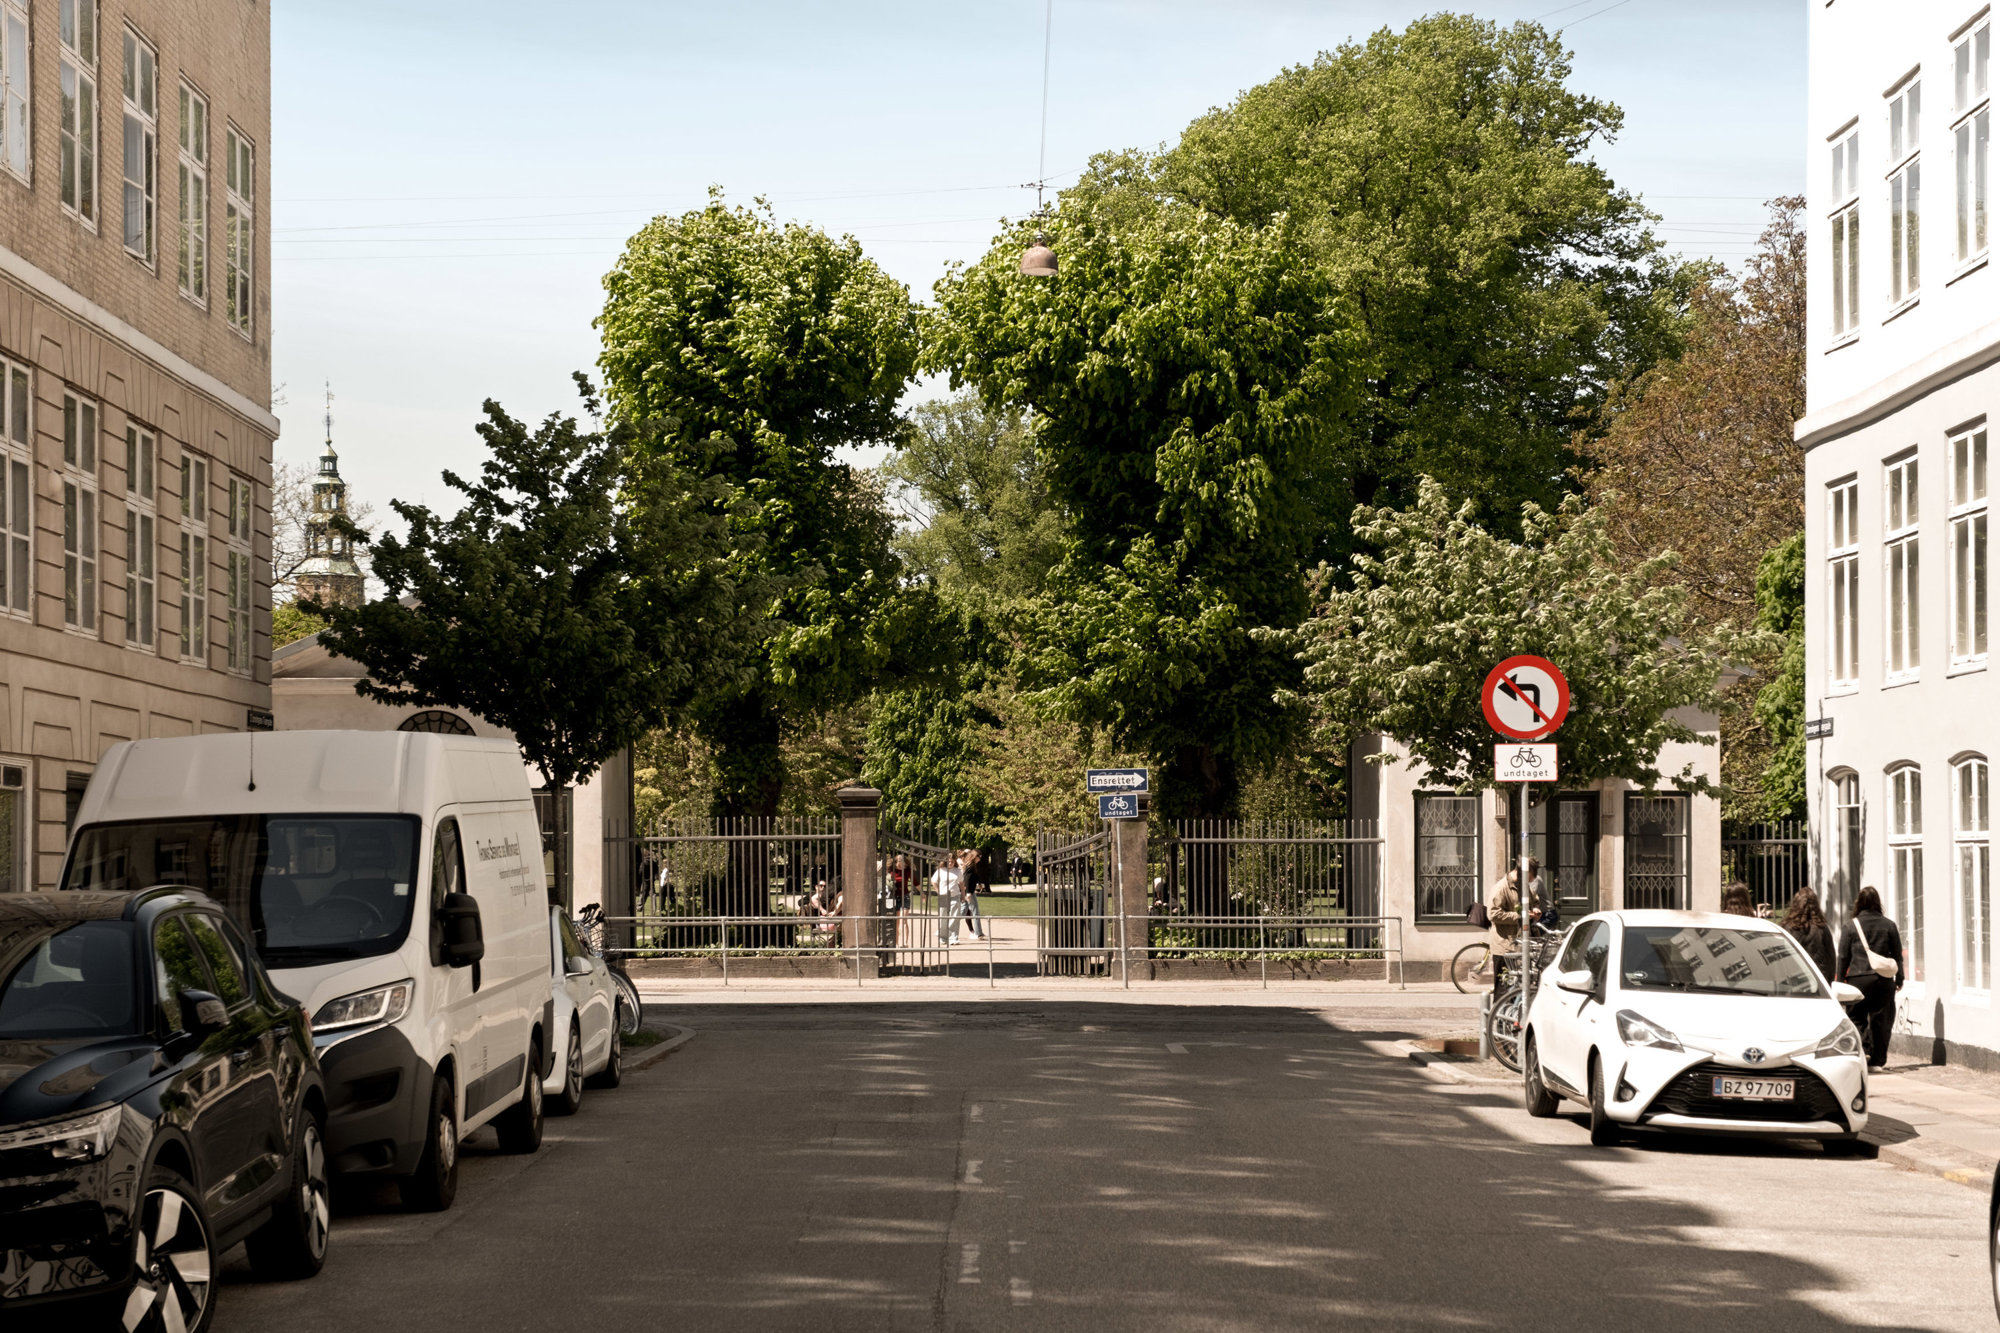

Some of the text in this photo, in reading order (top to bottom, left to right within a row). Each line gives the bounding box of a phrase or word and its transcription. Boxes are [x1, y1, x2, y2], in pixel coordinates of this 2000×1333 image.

[1503, 769, 1549, 778] undtaget
[1091, 776, 1135, 785] Ensrettet
[1723, 1081, 1742, 1094] BZ
[1745, 1081, 1763, 1095] 97
[1766, 1082, 1792, 1097] 709
